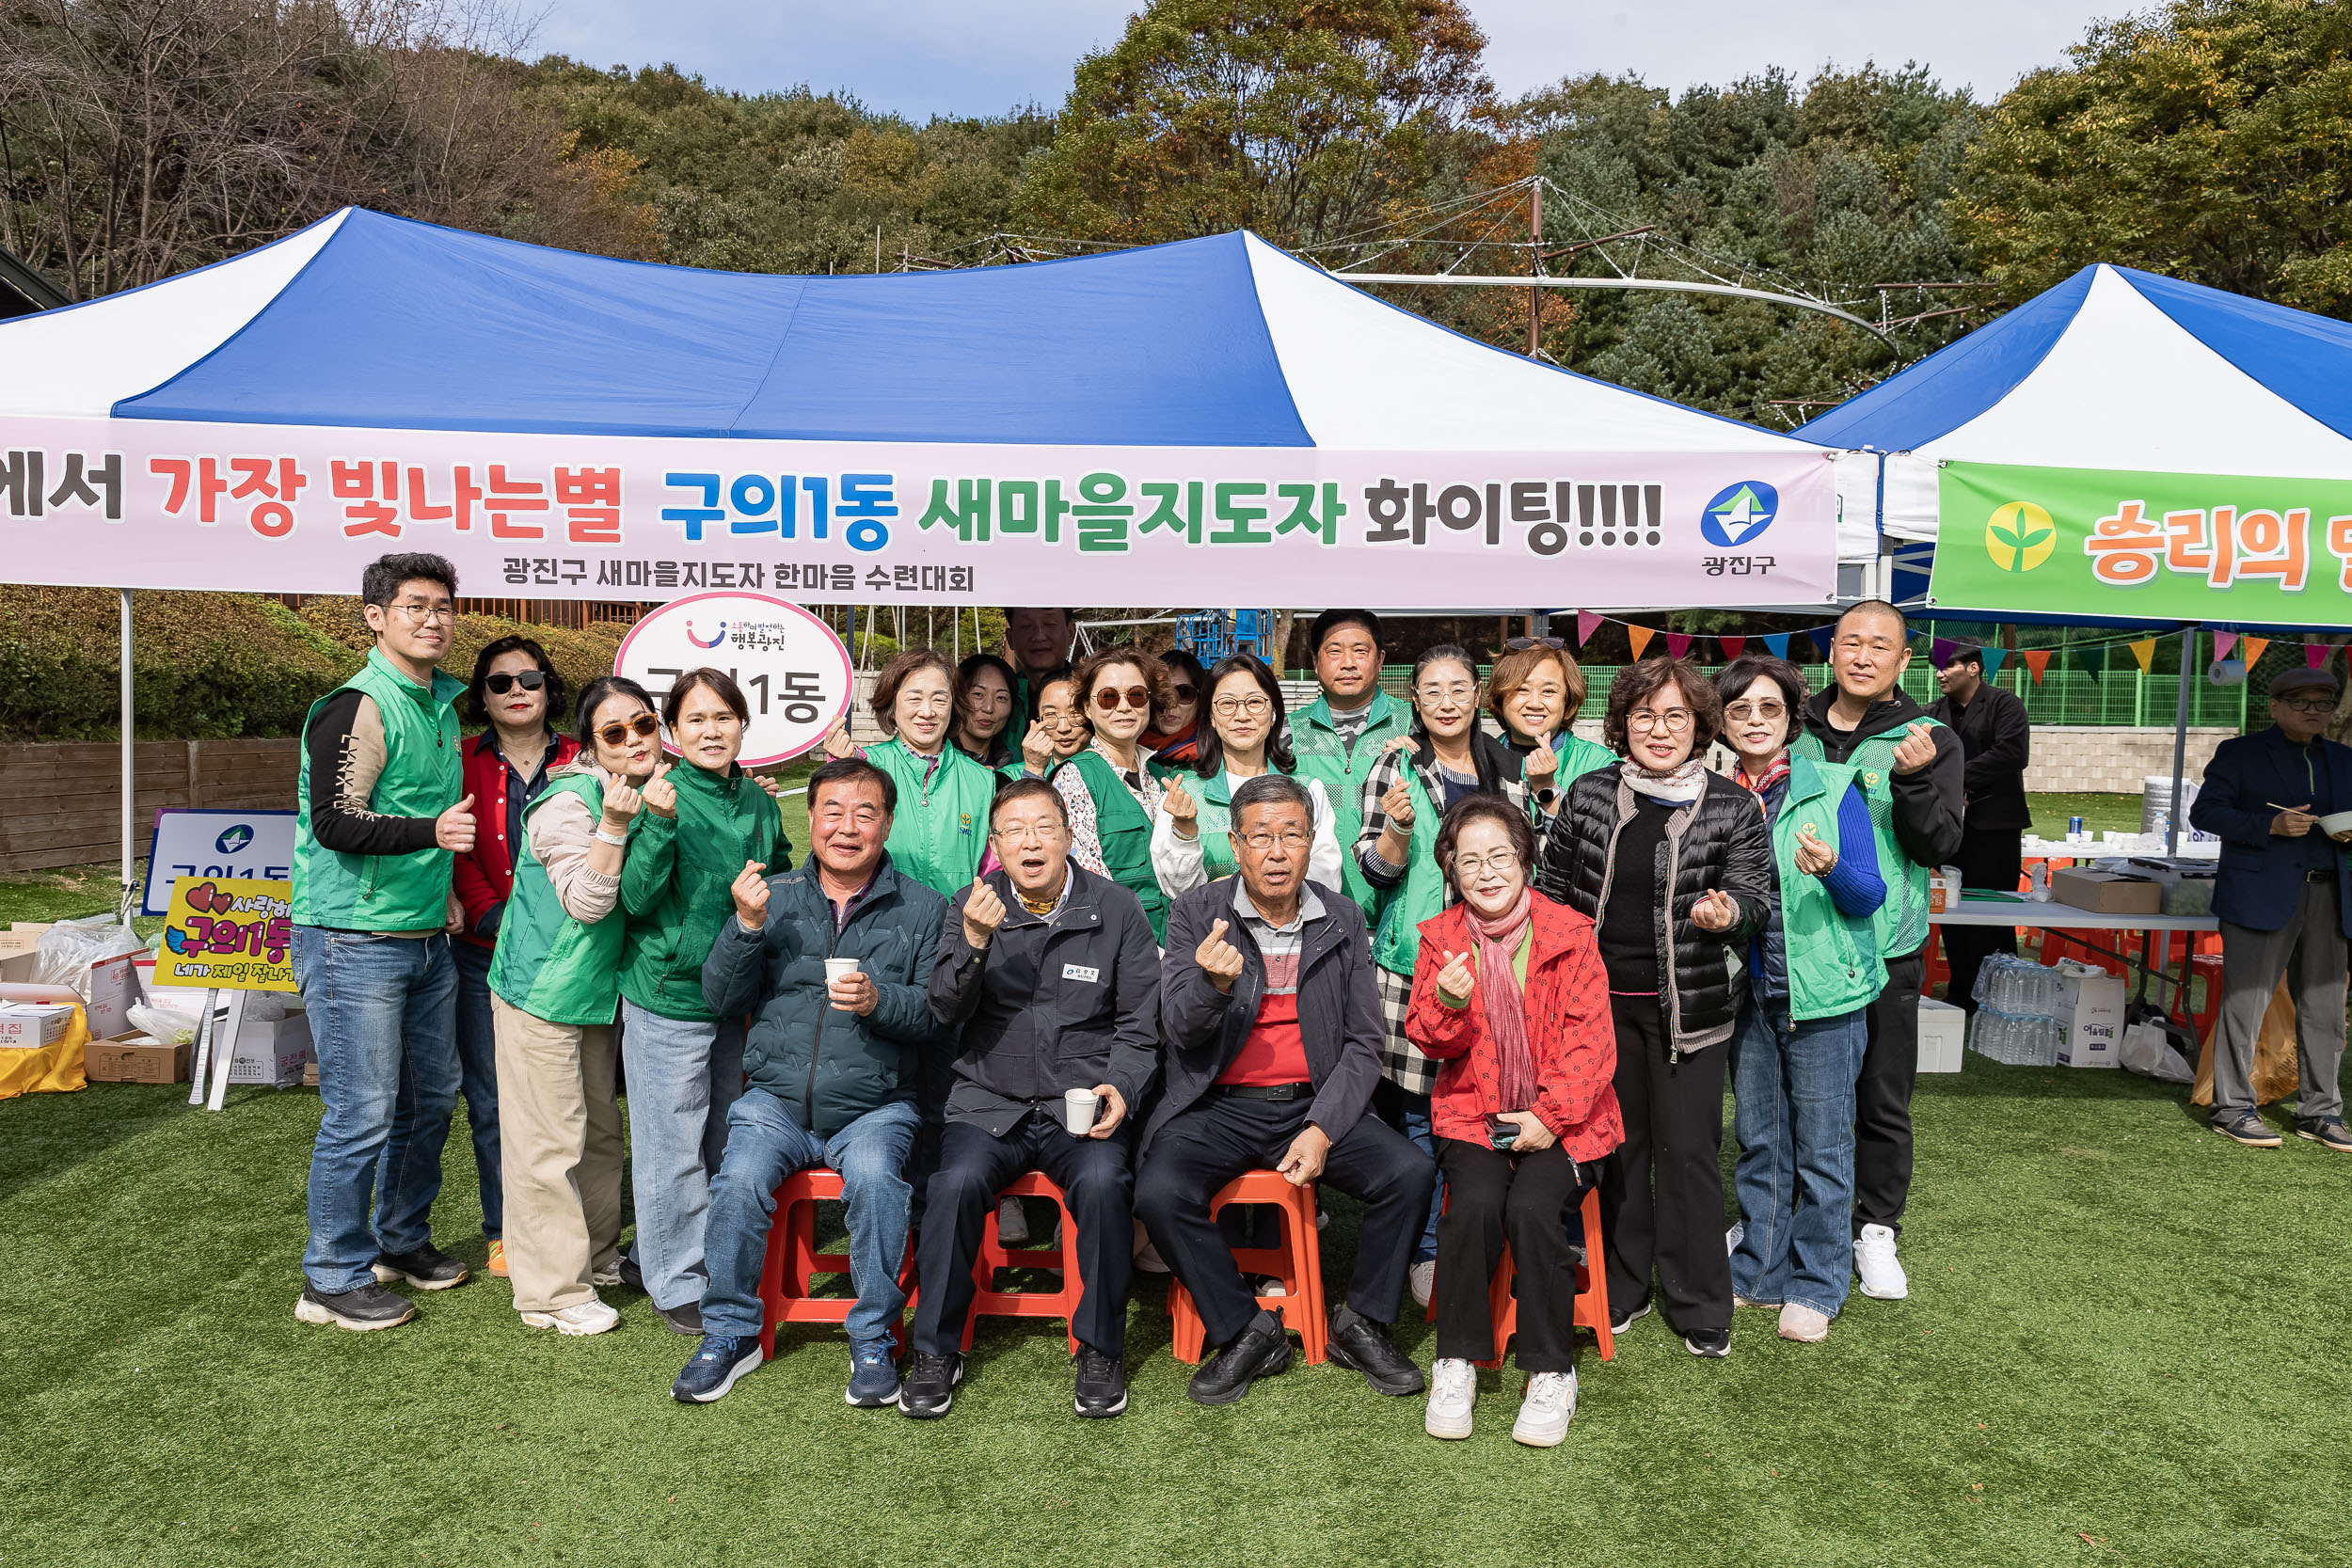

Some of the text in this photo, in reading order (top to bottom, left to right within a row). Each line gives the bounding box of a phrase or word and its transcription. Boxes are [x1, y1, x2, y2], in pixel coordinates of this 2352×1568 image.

[149, 457, 307, 538] 가장
[330, 458, 622, 544] 빛나는별
[661, 471, 899, 552] 구의1동
[918, 472, 1347, 553] 새마을지도자
[1364, 478, 1662, 556] 화이팅!!!!
[1701, 555, 1777, 577] 광진구
[2088, 502, 2308, 588] 승리의
[502, 557, 975, 594] 광진구 새마을지도자 한마음 수련대회
[731, 631, 785, 652] 행복광진
[647, 668, 826, 724] 구1동
[335, 734, 359, 787] LYNX
[181, 916, 293, 964] 구의1동
[174, 962, 211, 978] 네가
[212, 962, 249, 983] 제일
